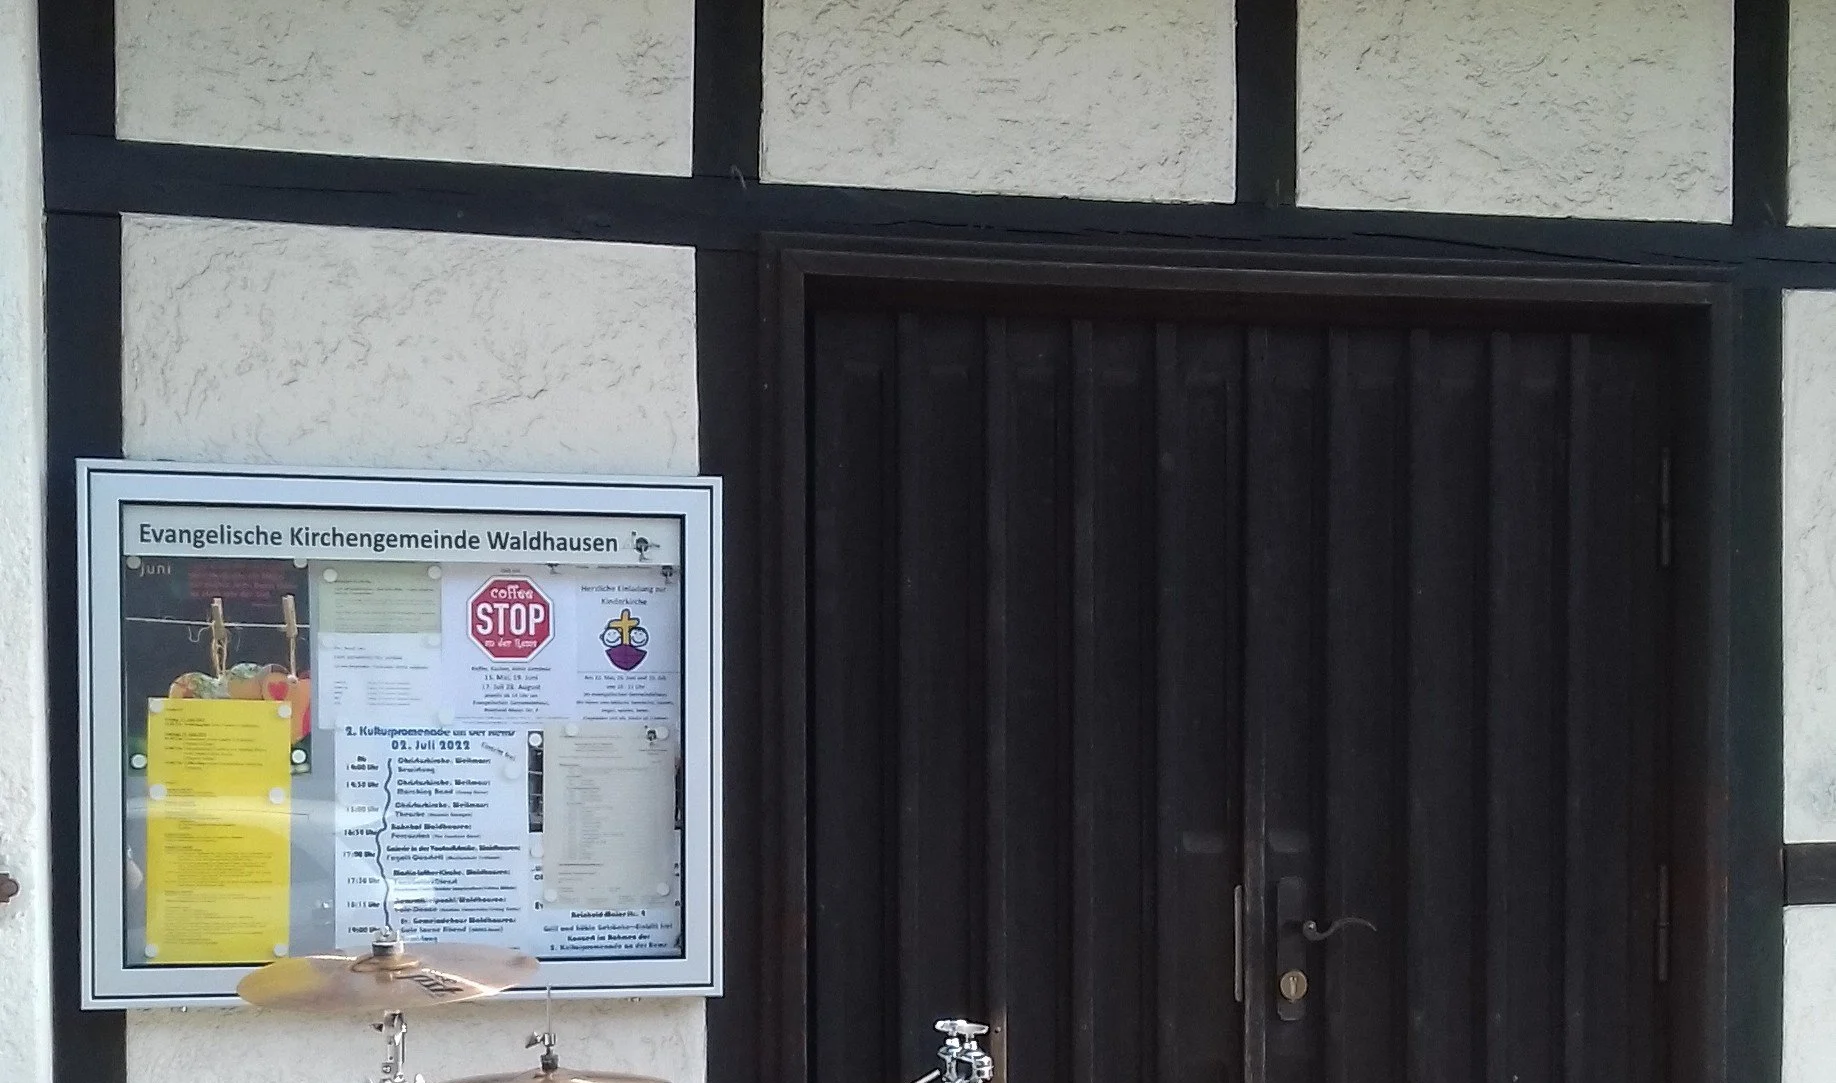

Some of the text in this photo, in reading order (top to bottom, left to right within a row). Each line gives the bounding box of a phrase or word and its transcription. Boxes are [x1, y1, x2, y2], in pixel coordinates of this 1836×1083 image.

[139, 523, 618, 552] Evangelische Kirchengemeinde Waldhausen
[140, 563, 171, 577] juni
[490, 584, 534, 599] coffee
[476, 602, 545, 636] STOP
[345, 726, 356, 736] 2.
[359, 726, 449, 738] Kulturpromenade
[391, 740, 470, 750] 02. Juli 2022
